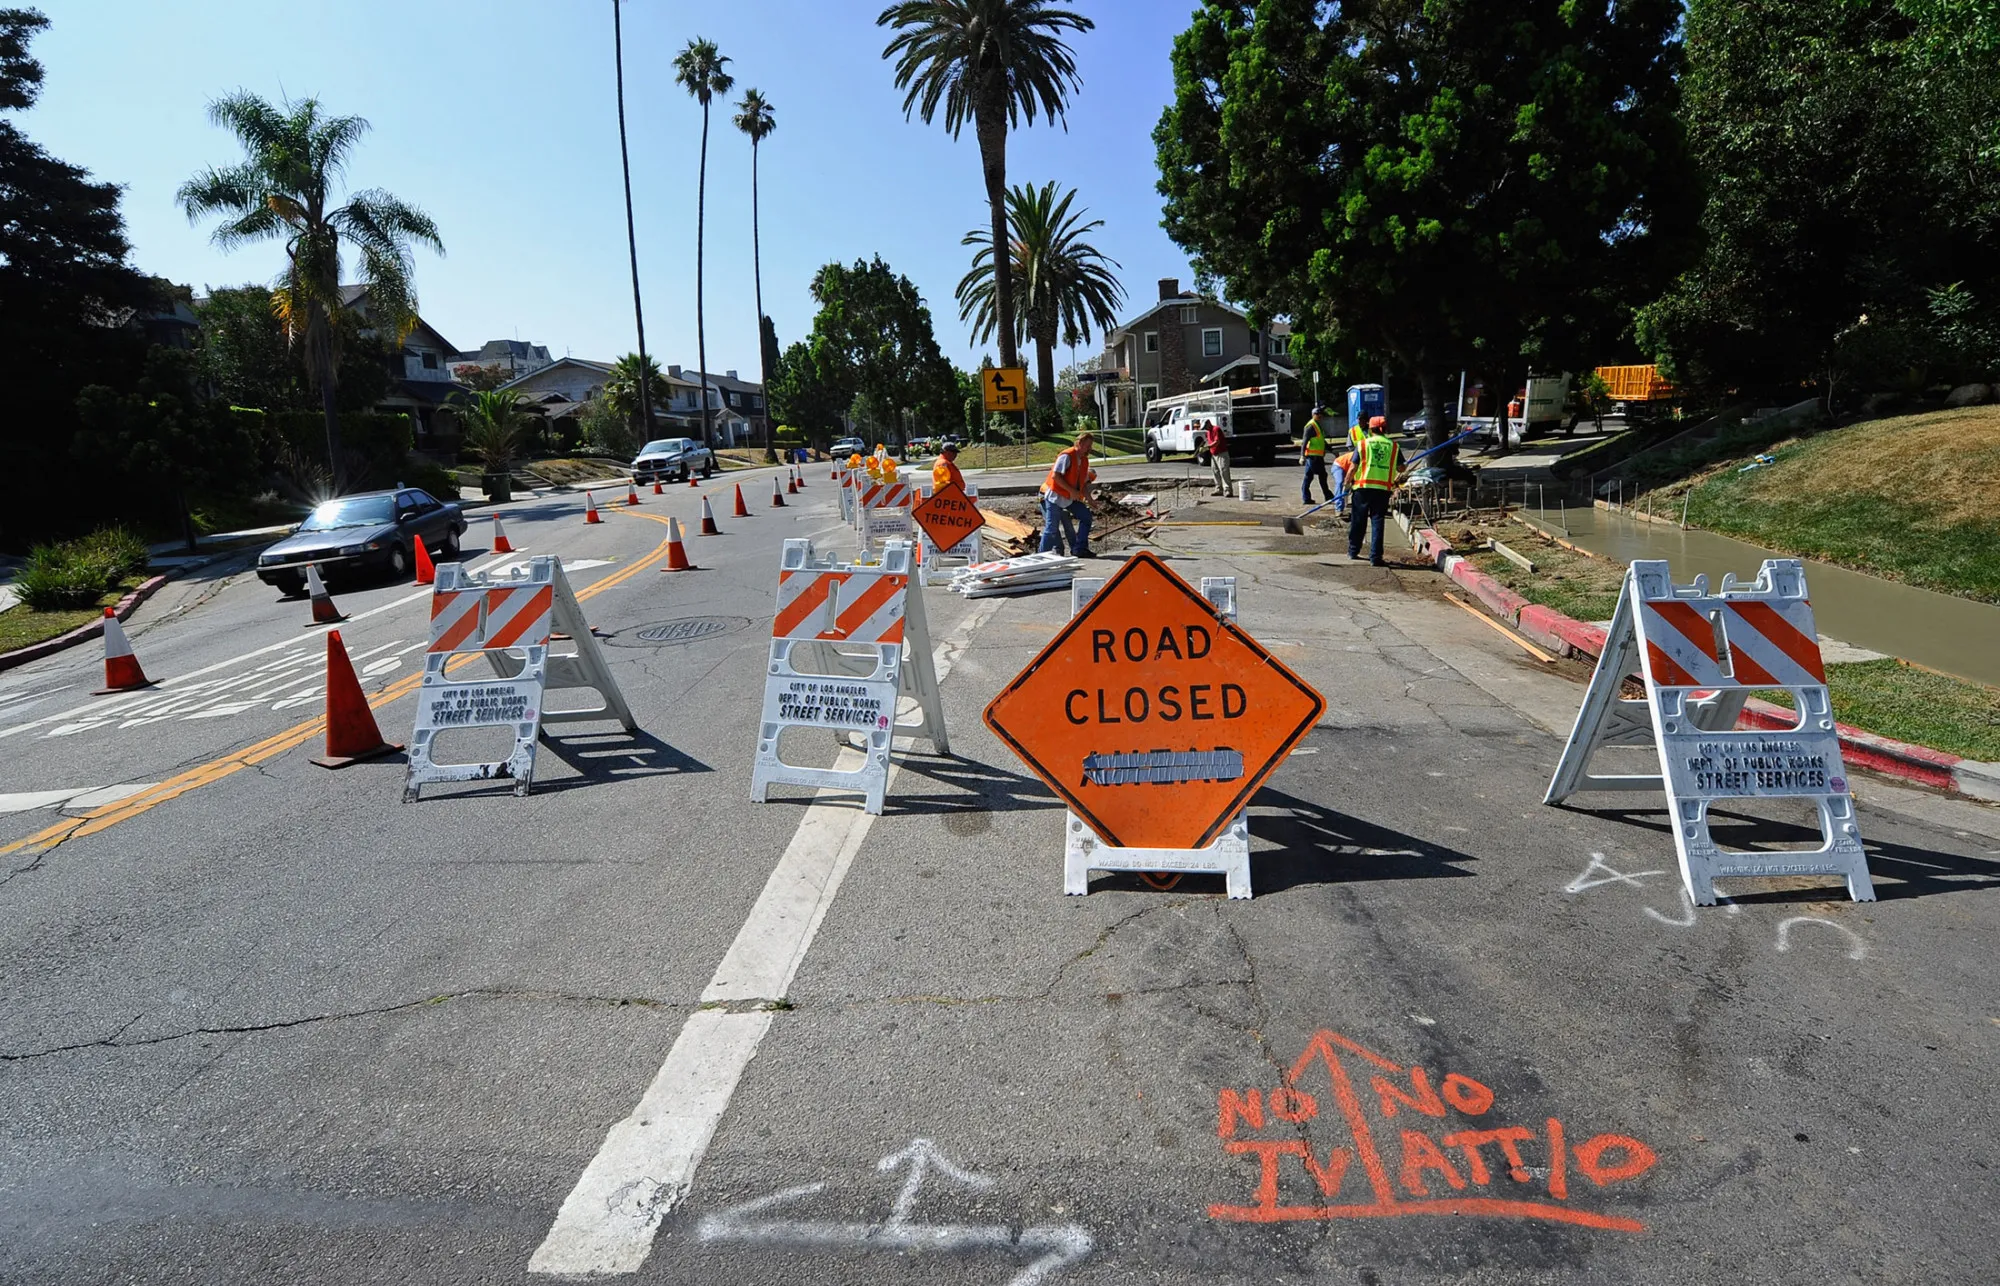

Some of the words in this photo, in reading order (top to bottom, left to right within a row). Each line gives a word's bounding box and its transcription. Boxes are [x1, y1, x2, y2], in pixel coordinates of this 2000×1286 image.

[996, 395, 1009, 405] 15
[934, 498, 967, 512] OPEN
[925, 512, 973, 528] TRENCH
[1092, 625, 1211, 663] ROAD
[471, 688, 485, 697] LOS
[789, 682, 806, 694] CITY
[808, 683, 818, 692] OF
[820, 684, 834, 693] LOS
[836, 685, 868, 696] ANGELES
[456, 699, 468, 709] OF
[470, 697, 499, 708] PUBLIC
[501, 695, 528, 706] WORKS
[778, 693, 802, 705] DEPT.
[805, 694, 817, 705] OF
[819, 695, 851, 708] PUBLIC
[852, 698, 881, 710] WORKS
[1065, 683, 1247, 725] CLOSED
[432, 709, 473, 726] STREET
[474, 705, 525, 723] SERVICES
[780, 704, 821, 720] STREET
[824, 707, 878, 725] SERVICES
[1697, 741, 1718, 753] CITY
[1738, 742, 1757, 753] LOS
[1760, 741, 1800, 753] ANGELES
[1686, 757, 1720, 771] DEPT.
[1724, 757, 1738, 772] OF
[1743, 756, 1783, 770] PUBLIC
[1787, 755, 1824, 769] WORKS
[1695, 771, 1749, 789] STREET
[1756, 770, 1825, 789] SERVICES
[1370, 1065, 1495, 1118] NO
[1218, 1087, 1318, 1138] NO
